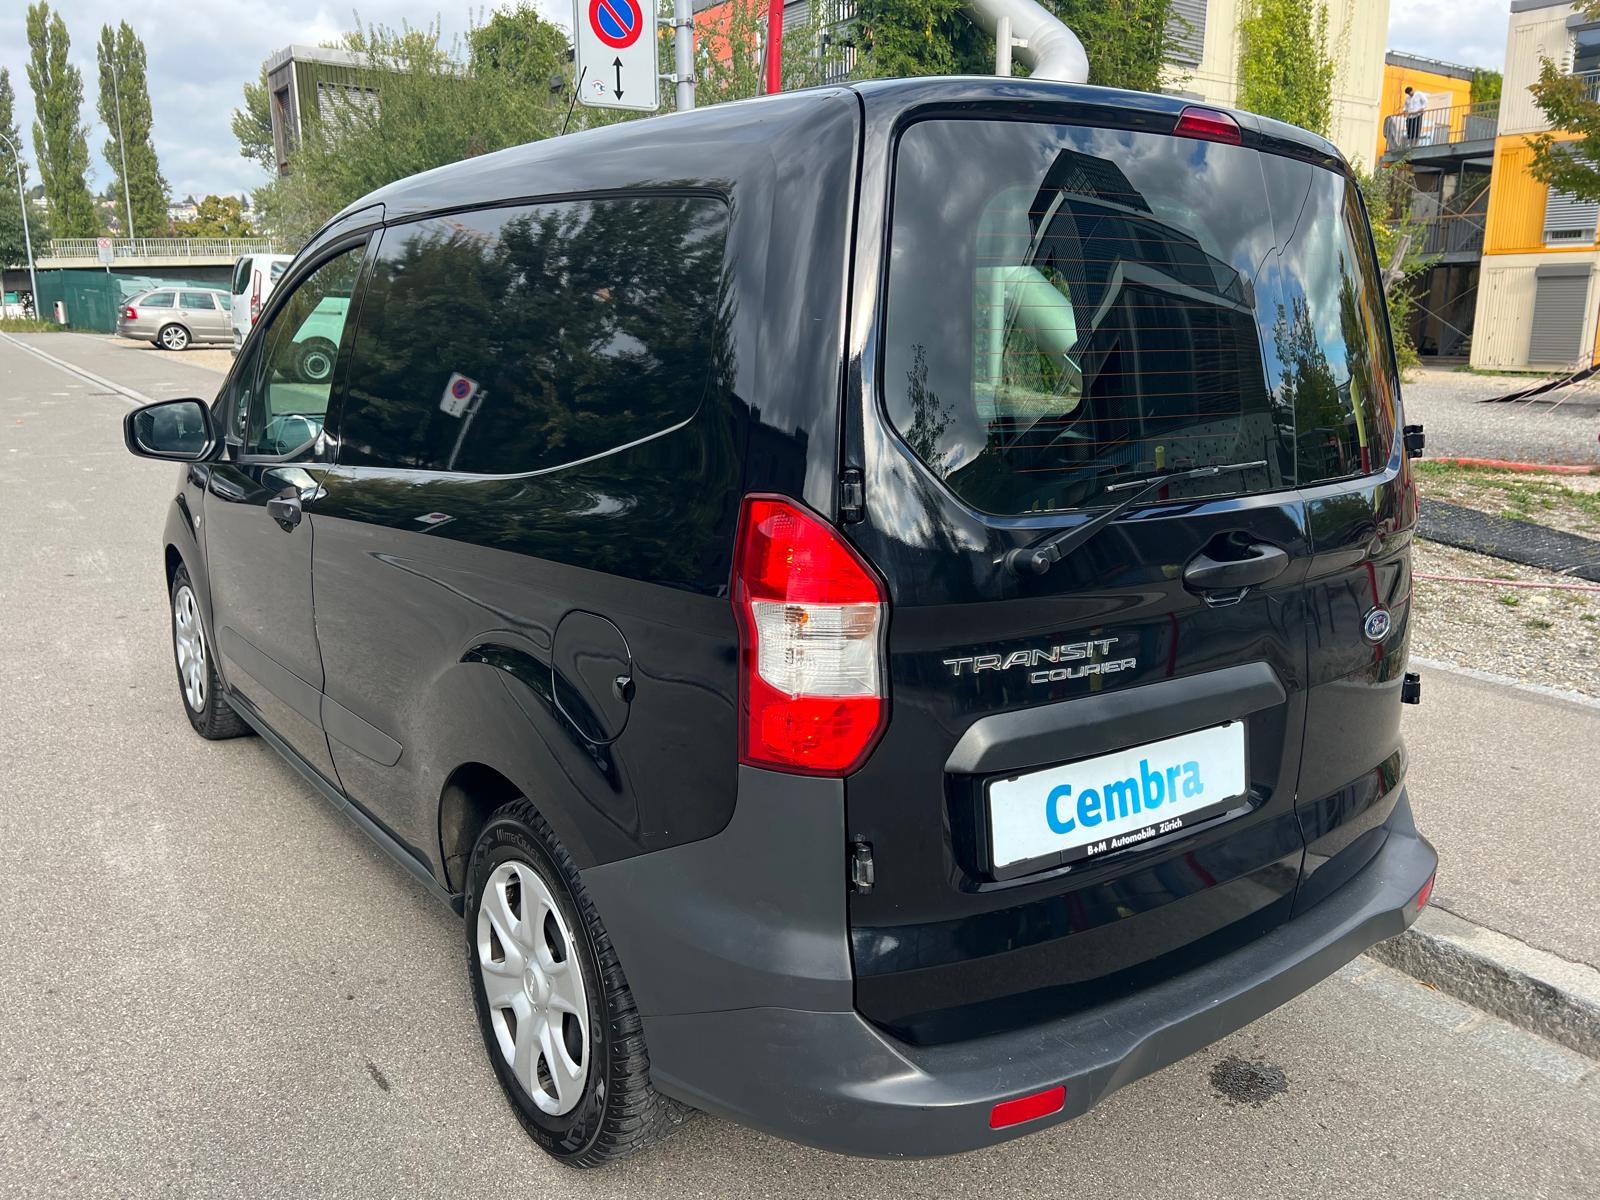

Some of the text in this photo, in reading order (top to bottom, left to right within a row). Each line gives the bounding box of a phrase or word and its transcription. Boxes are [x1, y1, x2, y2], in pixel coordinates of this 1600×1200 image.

[943, 637, 1119, 676] TRANSIT
[1030, 657, 1137, 684] COURIER
[1045, 759, 1204, 835] Cembra
[1087, 817, 1183, 856] B+M Automobile Zürich
